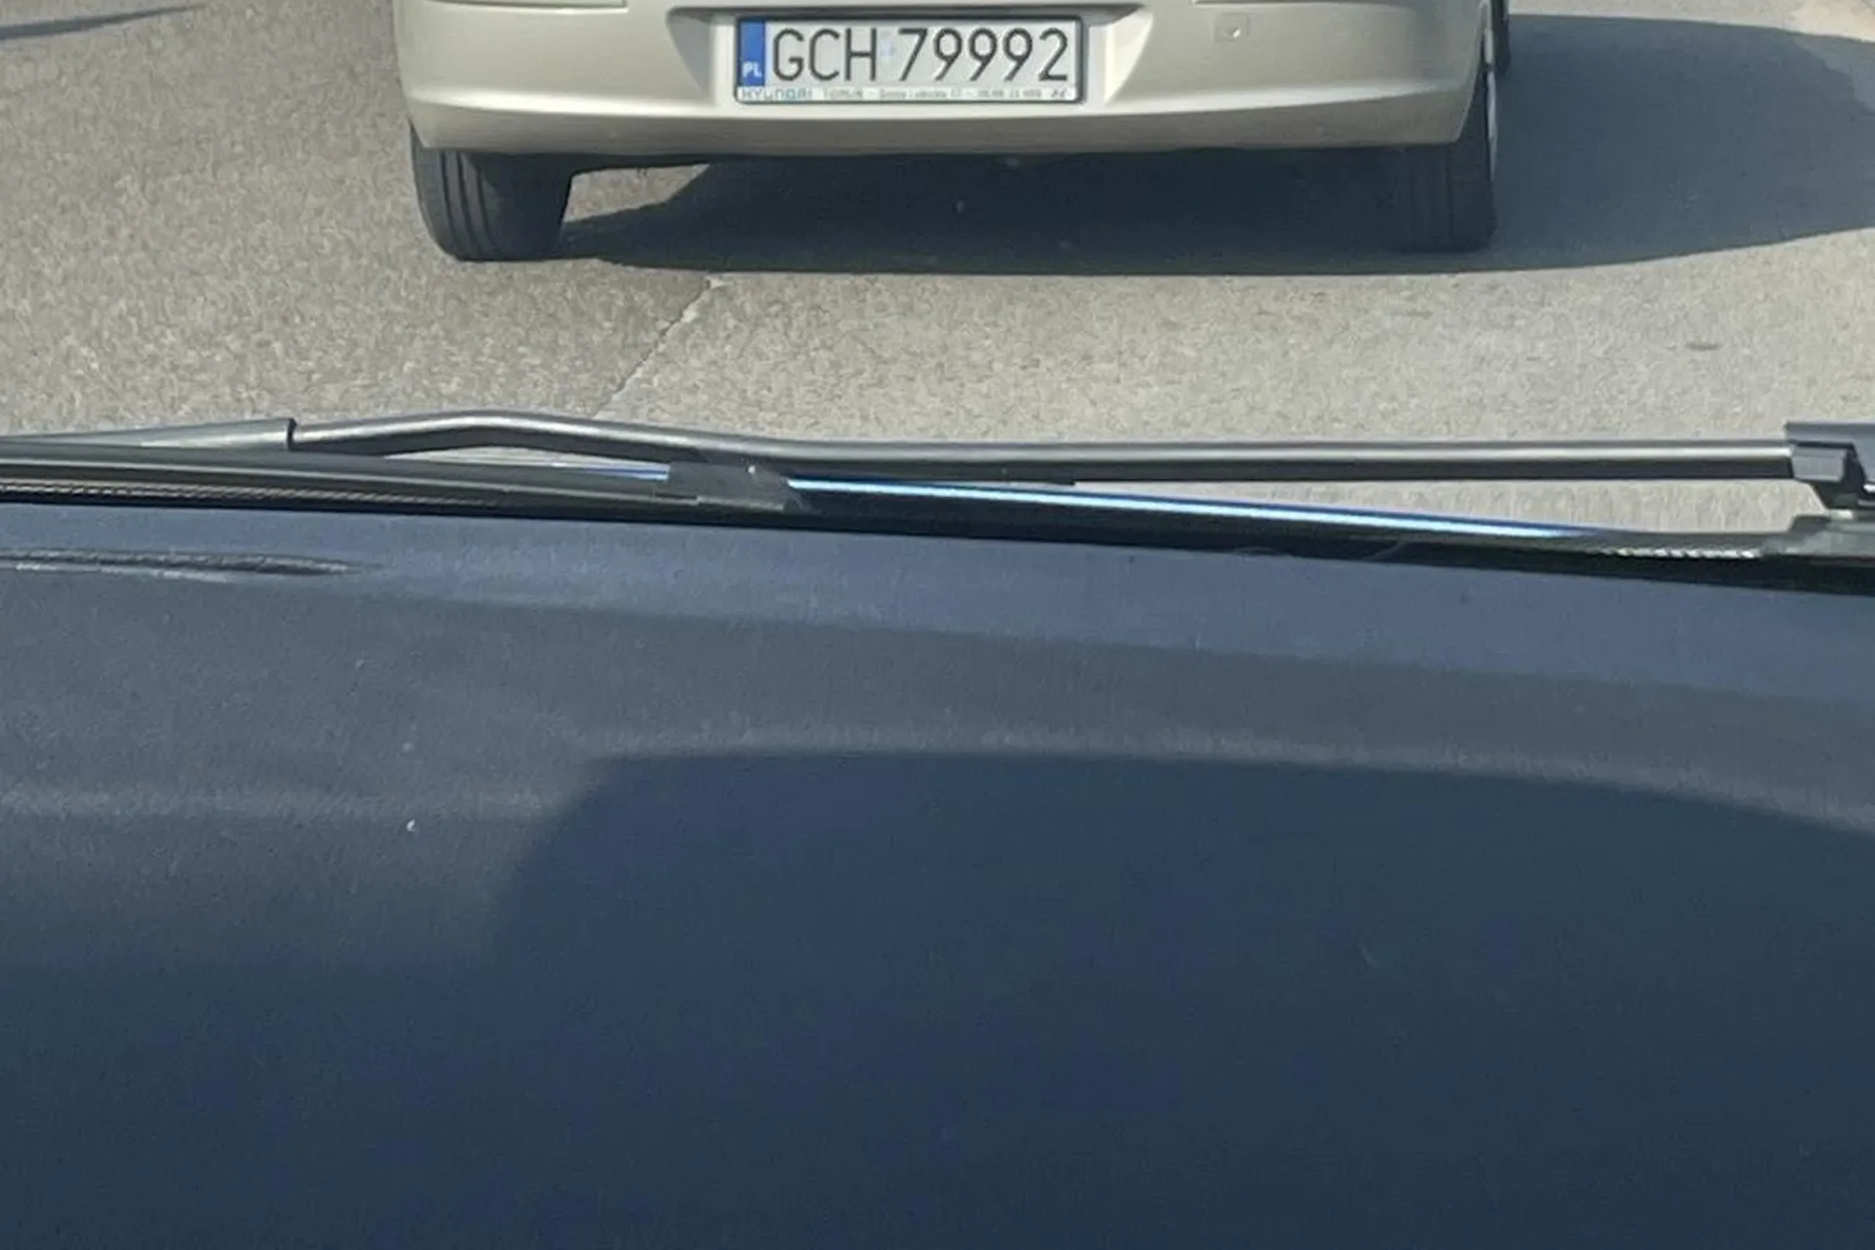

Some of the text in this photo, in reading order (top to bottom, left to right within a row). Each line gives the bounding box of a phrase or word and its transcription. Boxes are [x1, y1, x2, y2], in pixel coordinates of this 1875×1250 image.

[742, 61, 763, 78] PL
[773, 27, 1069, 82] GCH 79992
